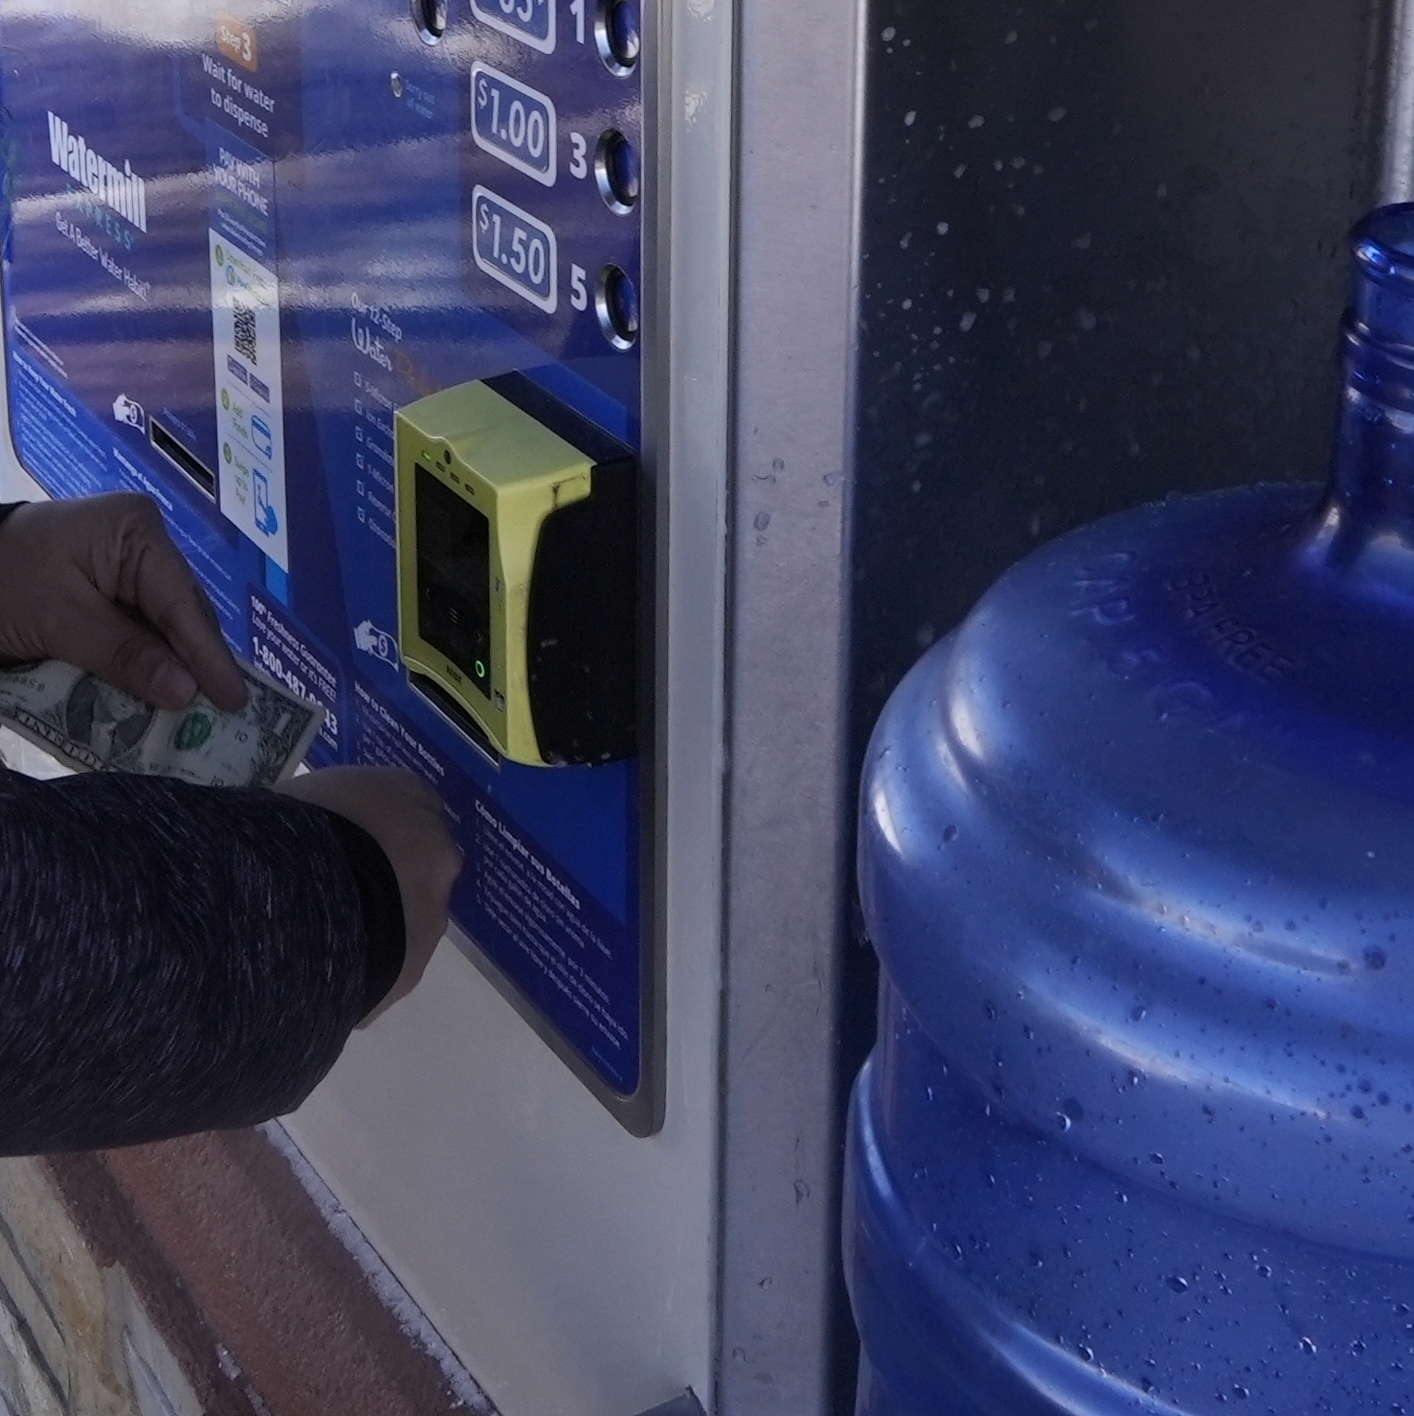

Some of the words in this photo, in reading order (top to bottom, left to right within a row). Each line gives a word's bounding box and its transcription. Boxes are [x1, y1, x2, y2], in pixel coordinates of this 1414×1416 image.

[220, 25, 241, 53] Step
[241, 32, 252, 62] 3
[201, 53, 226, 83] Wait
[227, 68, 243, 94] for
[244, 83, 276, 114] water
[210, 87, 223, 109] to
[223, 95, 269, 138] dispense
[477, 79, 545, 158] $1.00
[569, 131, 587, 179] 3
[236, 160, 260, 190] WITH
[238, 181, 269, 217] PHONE
[56, 211, 68, 238] Get
[69, 223, 76, 243] A
[76, 227, 98, 262] Better
[99, 247, 122, 281] Water
[479, 203, 545, 284] $1.50
[570, 262, 587, 312] 5
[351, 316, 392, 372] Water
[352, 292, 370, 317] Our
[370, 307, 403, 344] 12-Step
[252, 611, 266, 634] Love
[266, 626, 281, 647] your
[281, 640, 300, 666] water
[267, 611, 299, 652] Freshness
[300, 644, 336, 687] Guarantee
[1193, 612, 1297, 682] FREE
[355, 680, 370, 703] How
[371, 698, 378, 712] to
[379, 707, 399, 732] Clean
[399, 725, 416, 748] Your
[417, 743, 445, 777] Bottles
[475, 799, 497, 829] Cómo
[498, 818, 529, 860] Limpiar
[531, 847, 545, 875] sus
[546, 862, 581, 910] Botellas
